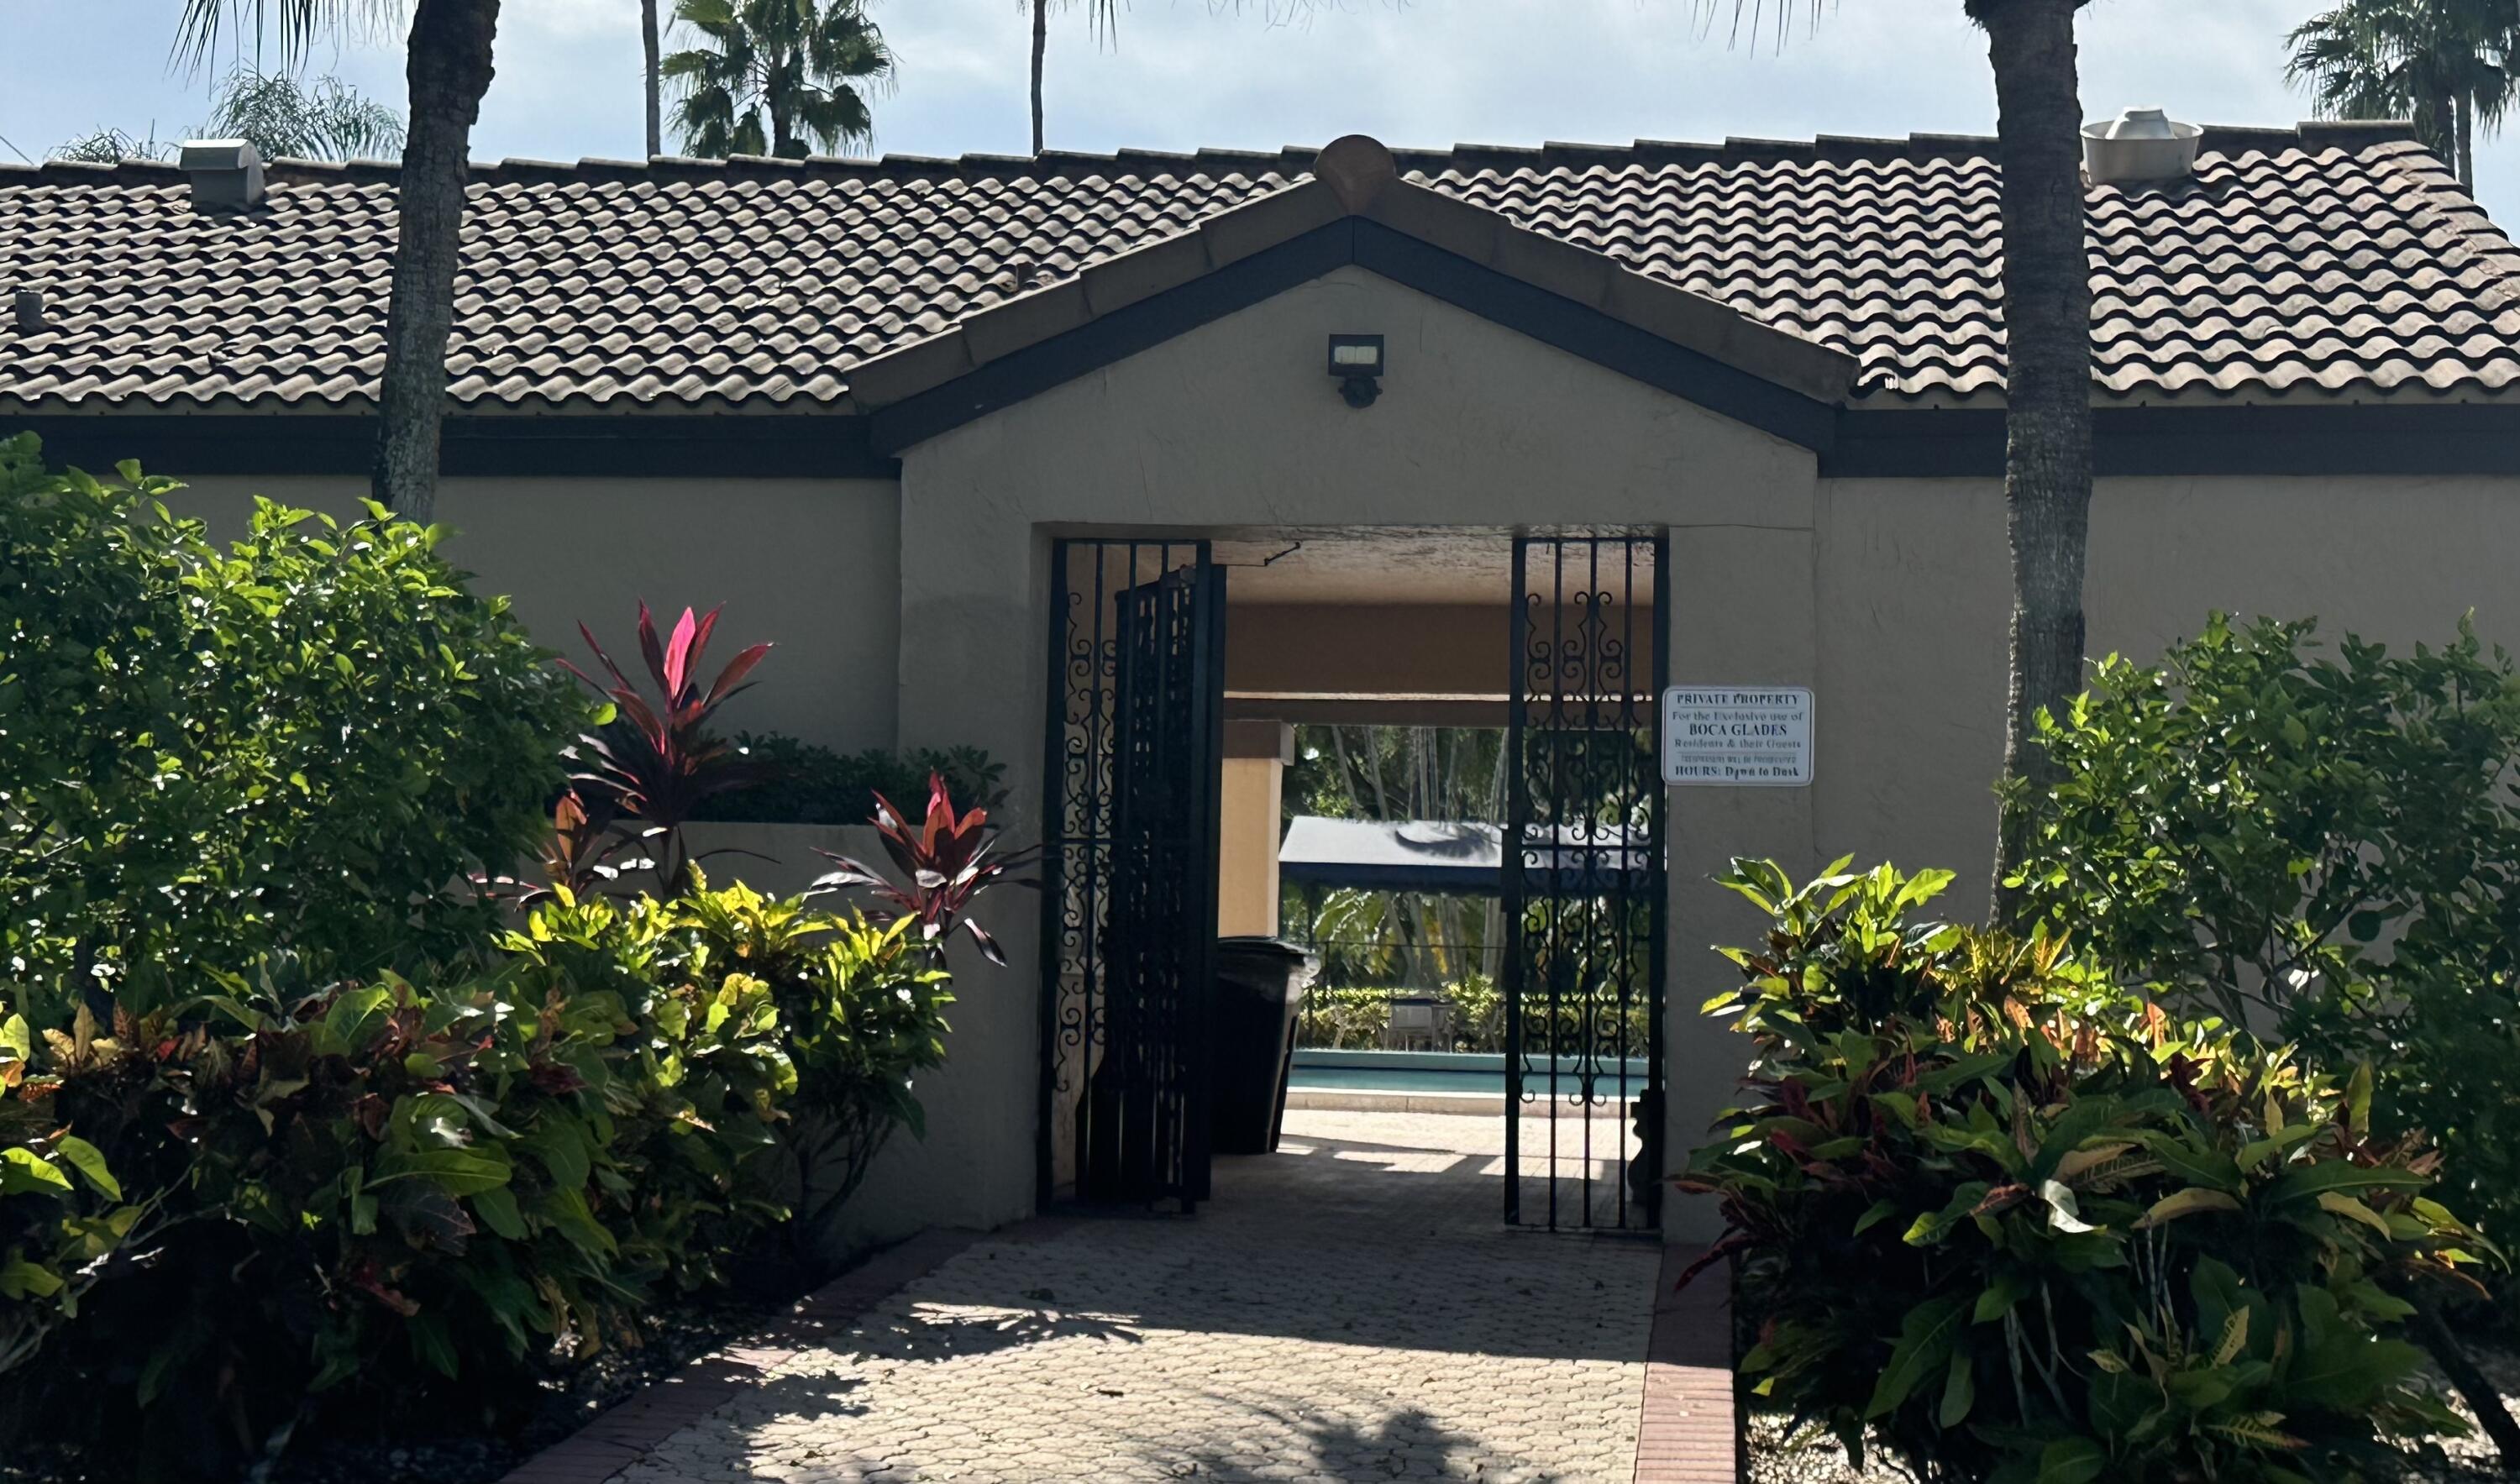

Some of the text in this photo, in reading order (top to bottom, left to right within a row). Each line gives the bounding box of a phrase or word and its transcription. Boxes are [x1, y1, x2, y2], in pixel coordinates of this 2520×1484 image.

[1677, 693, 1799, 705] PRIVATE PROPERTY
[1672, 711, 1803, 721] For the Exclusive use of
[1689, 724, 1787, 736] BOCA GLADES
[1675, 738, 1801, 749] Residents & their Guests
[1675, 765, 1799, 779] HOURS: Dawn to Dusk
